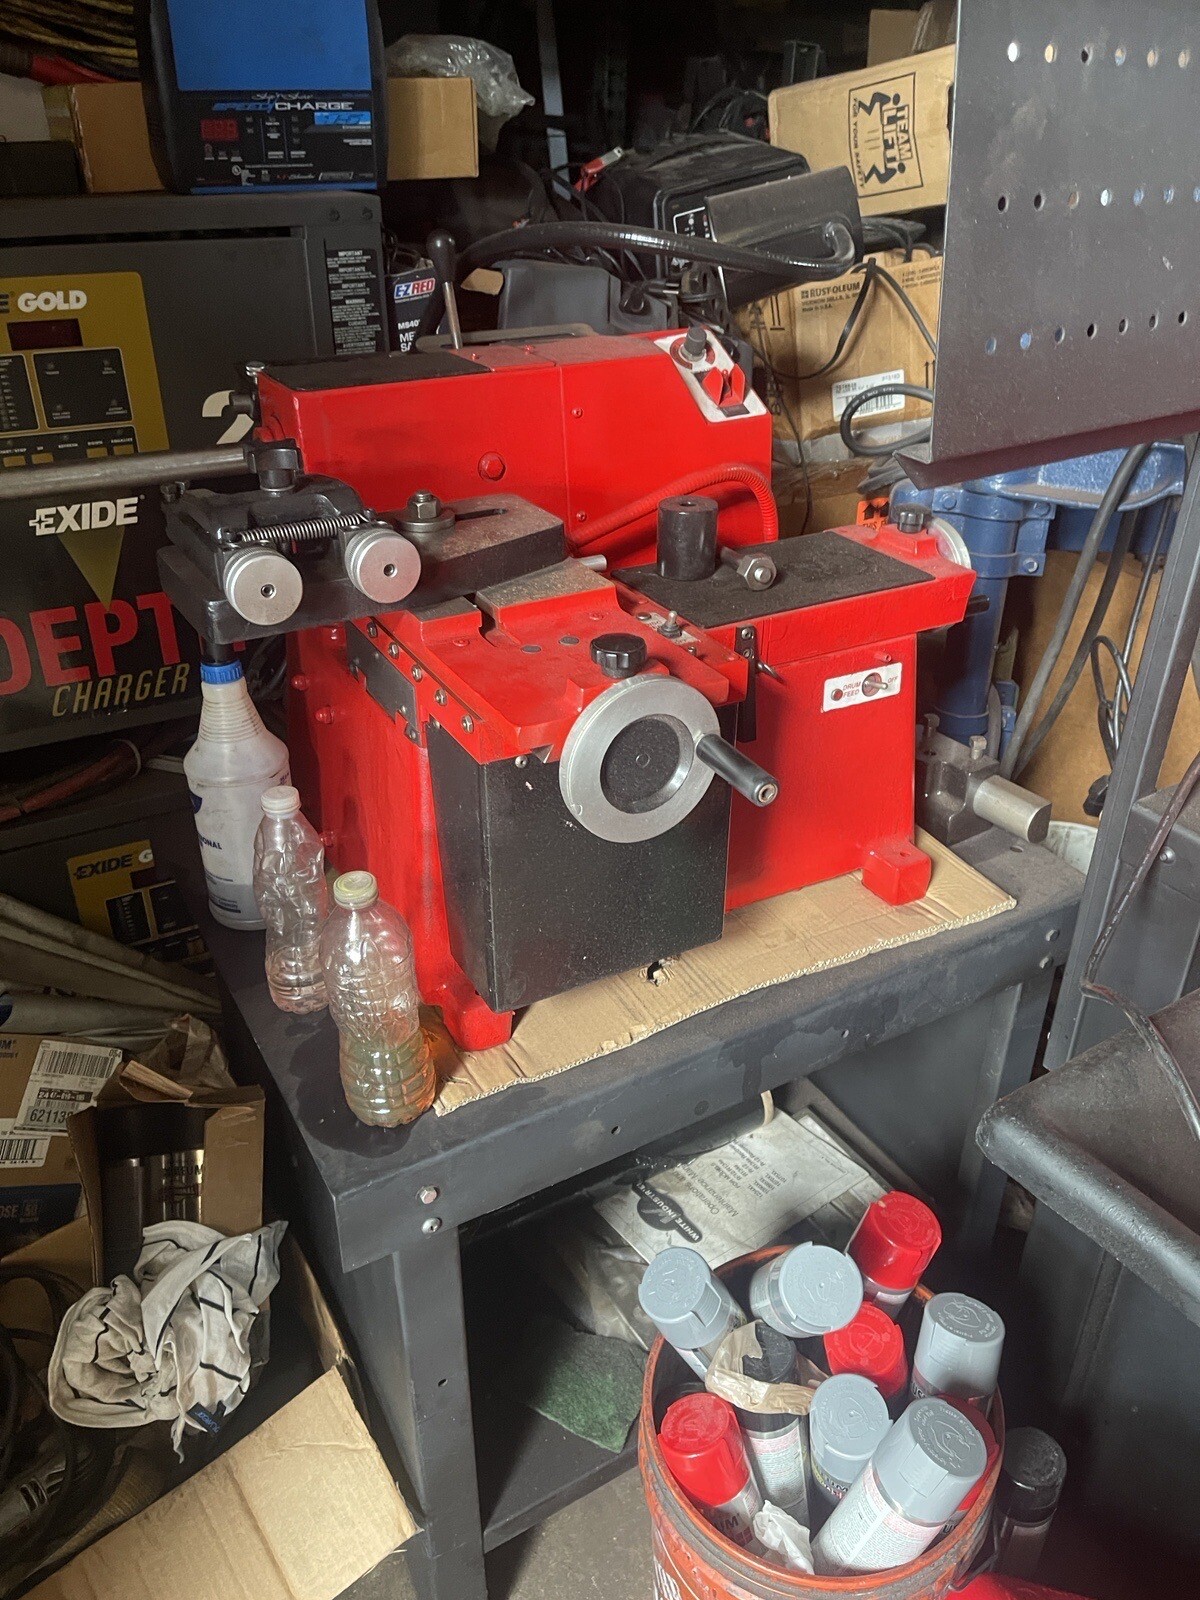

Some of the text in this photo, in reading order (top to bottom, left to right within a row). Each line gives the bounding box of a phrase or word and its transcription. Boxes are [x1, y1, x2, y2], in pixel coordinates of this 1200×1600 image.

[897, 105, 912, 160] TEAM
[855, 152, 865, 188] SAFETY
[17, 290, 87, 313] GOLD
[398, 319, 420, 330] MS40
[29, 497, 138, 536] EXIDE
[0, 592, 246, 695] DEPT
[52, 663, 190, 717] CHARGER
[842, 676, 899, 691] DRUM OFF
[842, 689, 860, 698] FEED
[73, 853, 133, 880] EXIDE
[684, 1180, 720, 1216] Operations
[696, 1177, 739, 1218] Maintenance
[674, 1217, 700, 1242] WHITE
